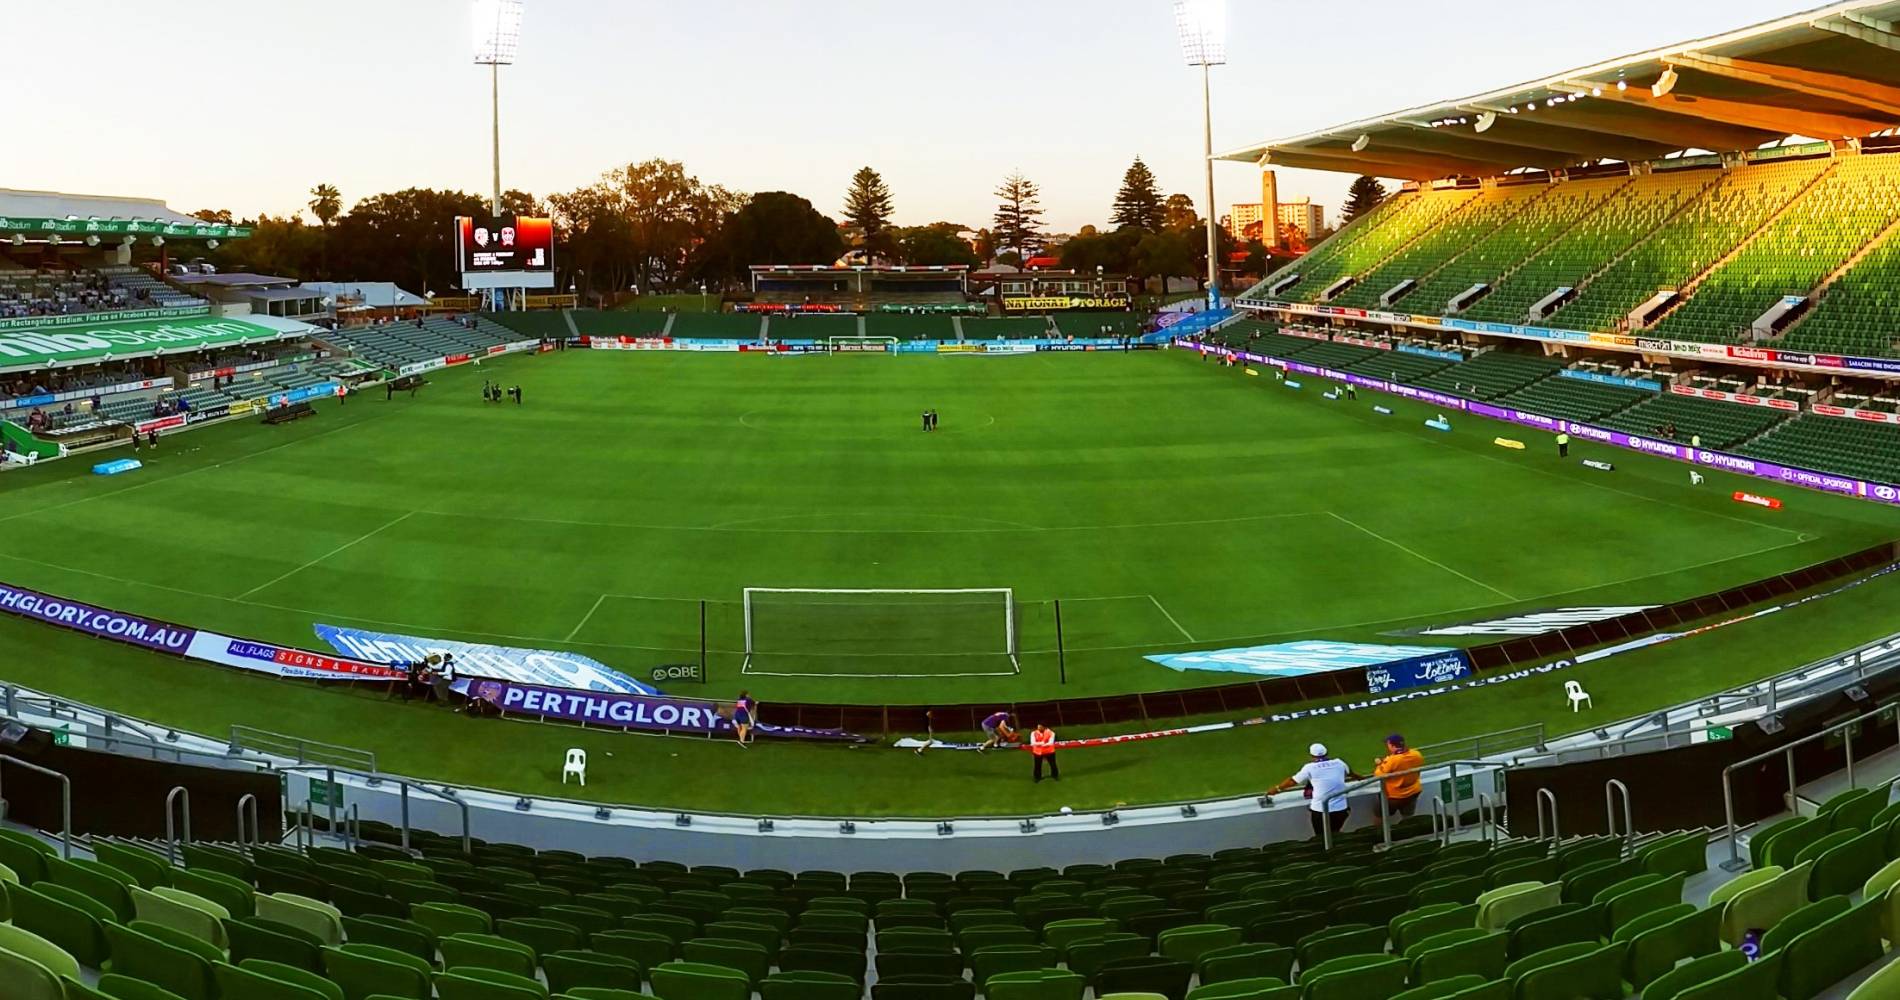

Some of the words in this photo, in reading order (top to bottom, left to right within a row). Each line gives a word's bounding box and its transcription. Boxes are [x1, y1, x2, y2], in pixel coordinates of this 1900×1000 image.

[42, 219, 55, 229] nib
[87, 221, 99, 231] nib
[1006, 298, 1067, 310] NATIONAL
[86, 323, 255, 346] Stadium
[1581, 426, 1611, 440] HYUNDAI
[1641, 440, 1677, 455] HYUNDAI
[1715, 454, 1754, 471] HYUNDAI
[229, 643, 245, 654] ALL
[247, 645, 275, 658] FLAGS
[278, 652, 324, 668] SIGNS
[667, 666, 699, 678] QBE
